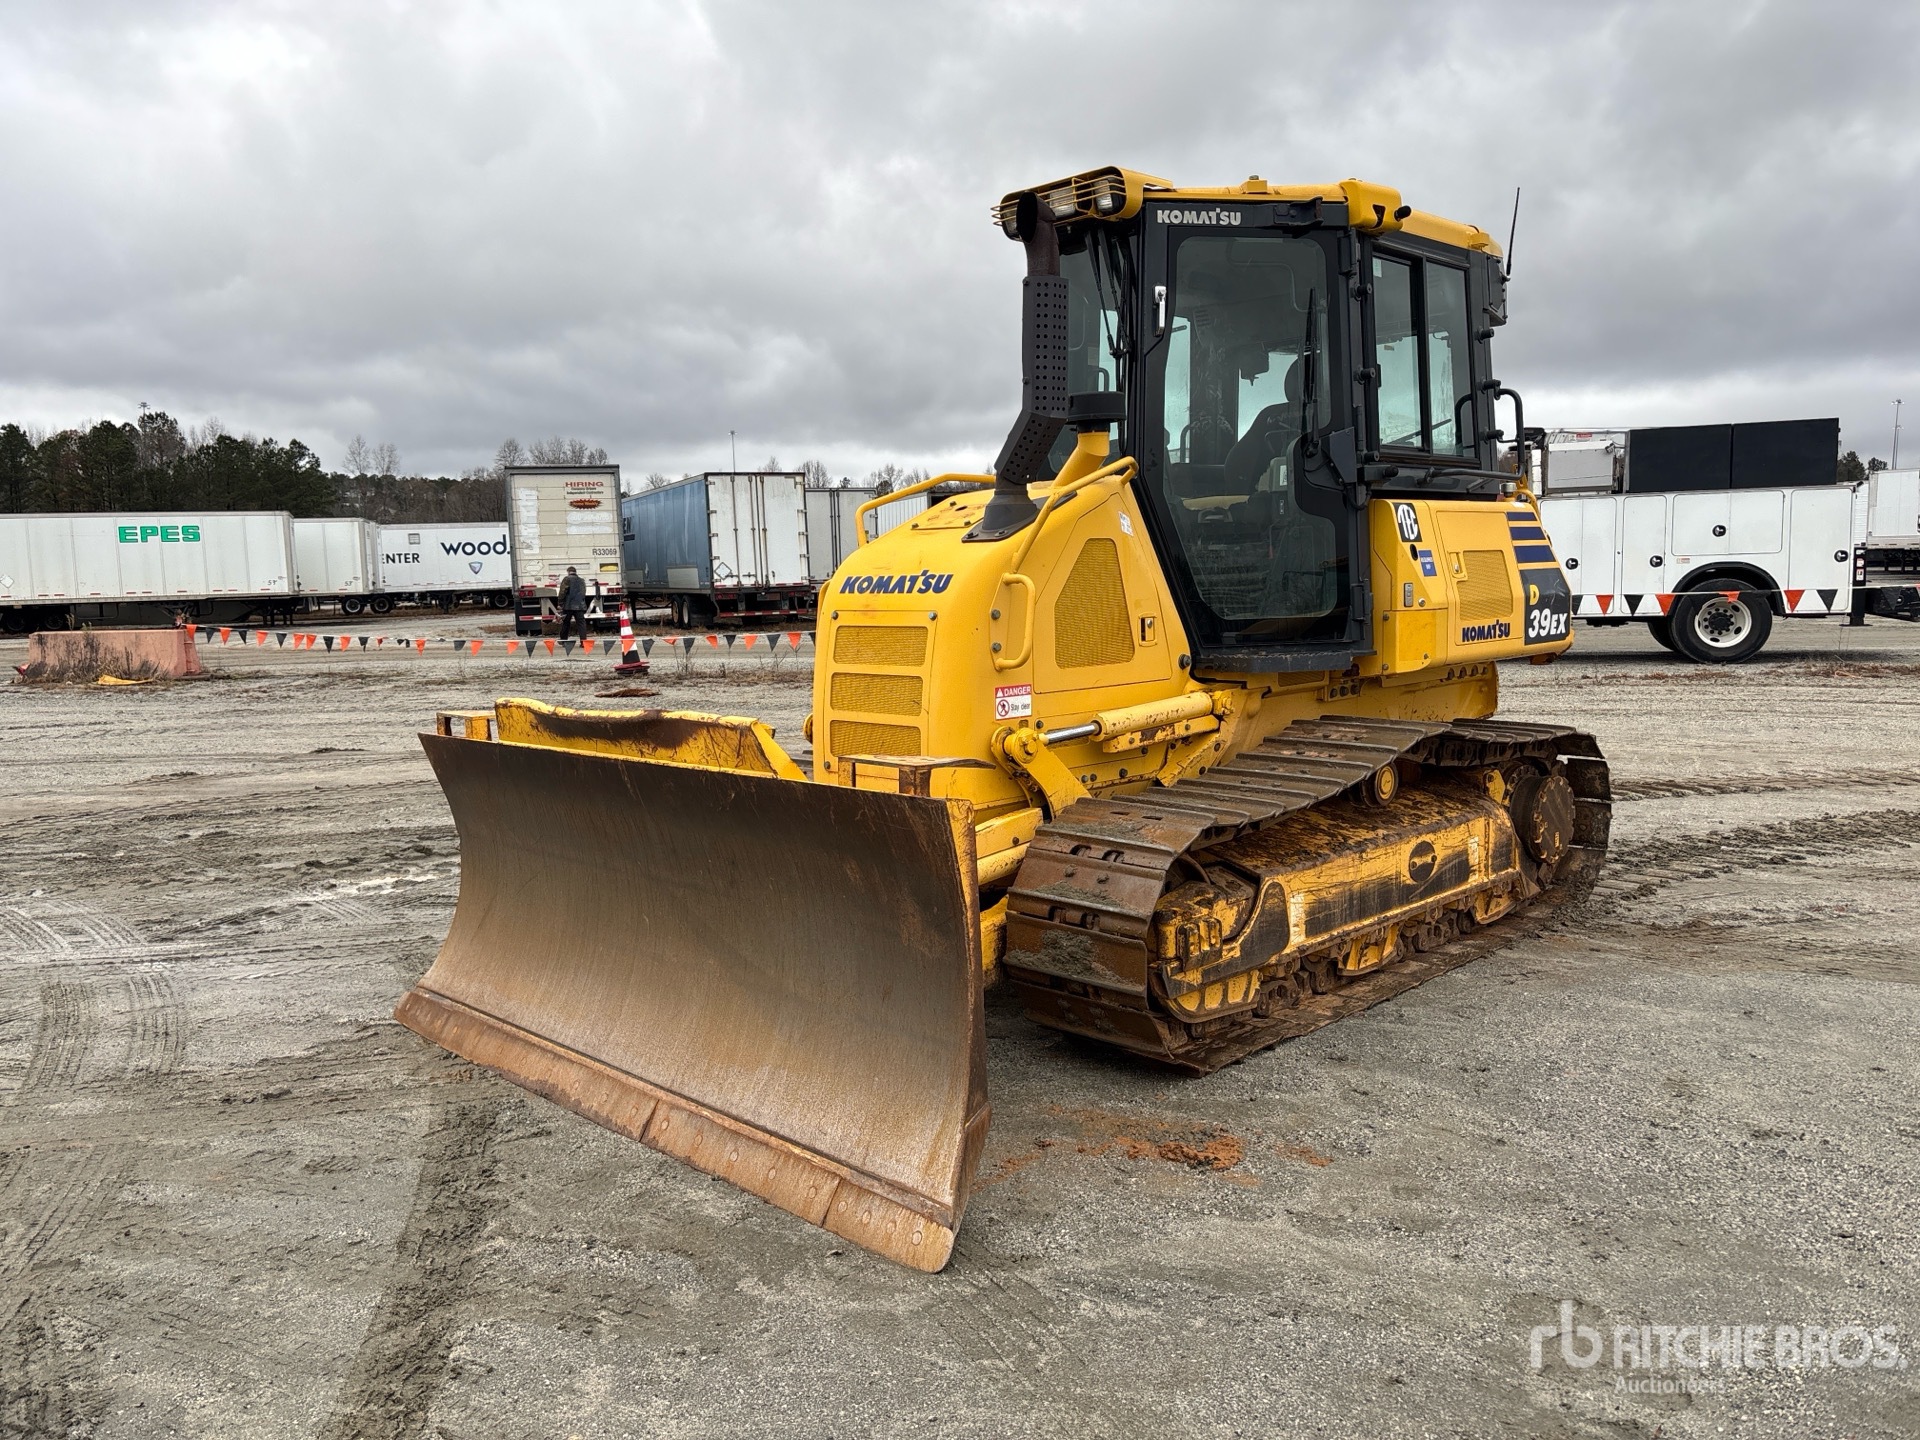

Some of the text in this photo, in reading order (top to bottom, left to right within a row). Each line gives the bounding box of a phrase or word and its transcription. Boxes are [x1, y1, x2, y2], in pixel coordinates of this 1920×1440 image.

[1157, 207, 1242, 226] KOMATSU
[118, 525, 201, 544] EPES
[839, 569, 954, 595] KOMATSU
[1462, 619, 1511, 643] KOMATSU
[1004, 686, 1031, 697] DANGER
